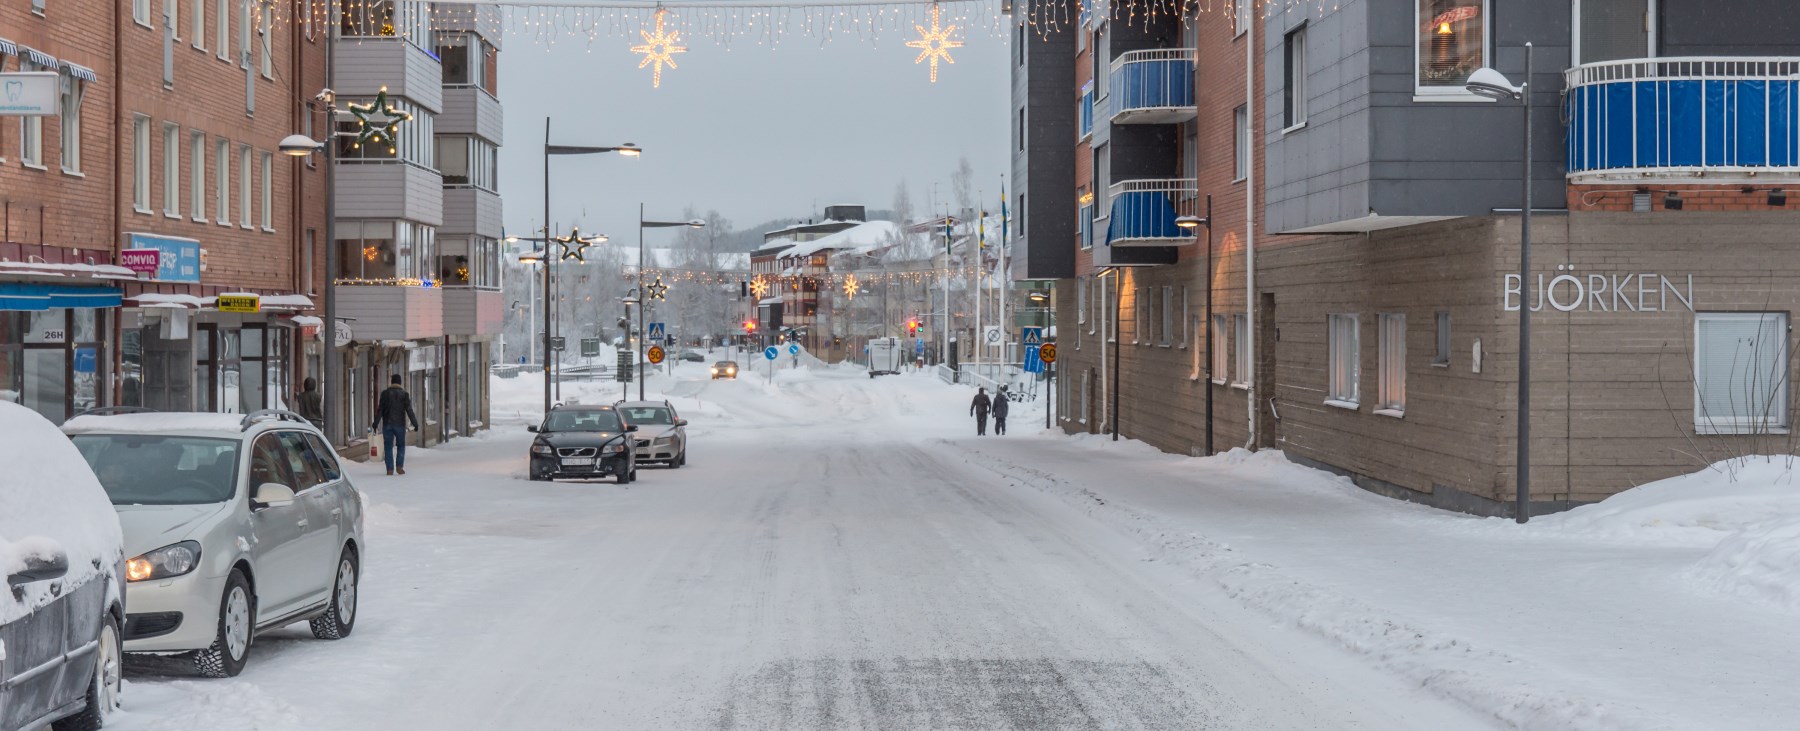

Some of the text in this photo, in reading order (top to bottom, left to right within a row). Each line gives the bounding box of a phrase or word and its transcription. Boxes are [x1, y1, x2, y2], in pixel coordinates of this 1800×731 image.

[121, 254, 156, 265] COMVIQ
[1504, 264, 1693, 312] BJÖRKEN
[44, 331, 63, 339] 26H
[650, 351, 661, 360] 50
[1043, 349, 1055, 358] 50
